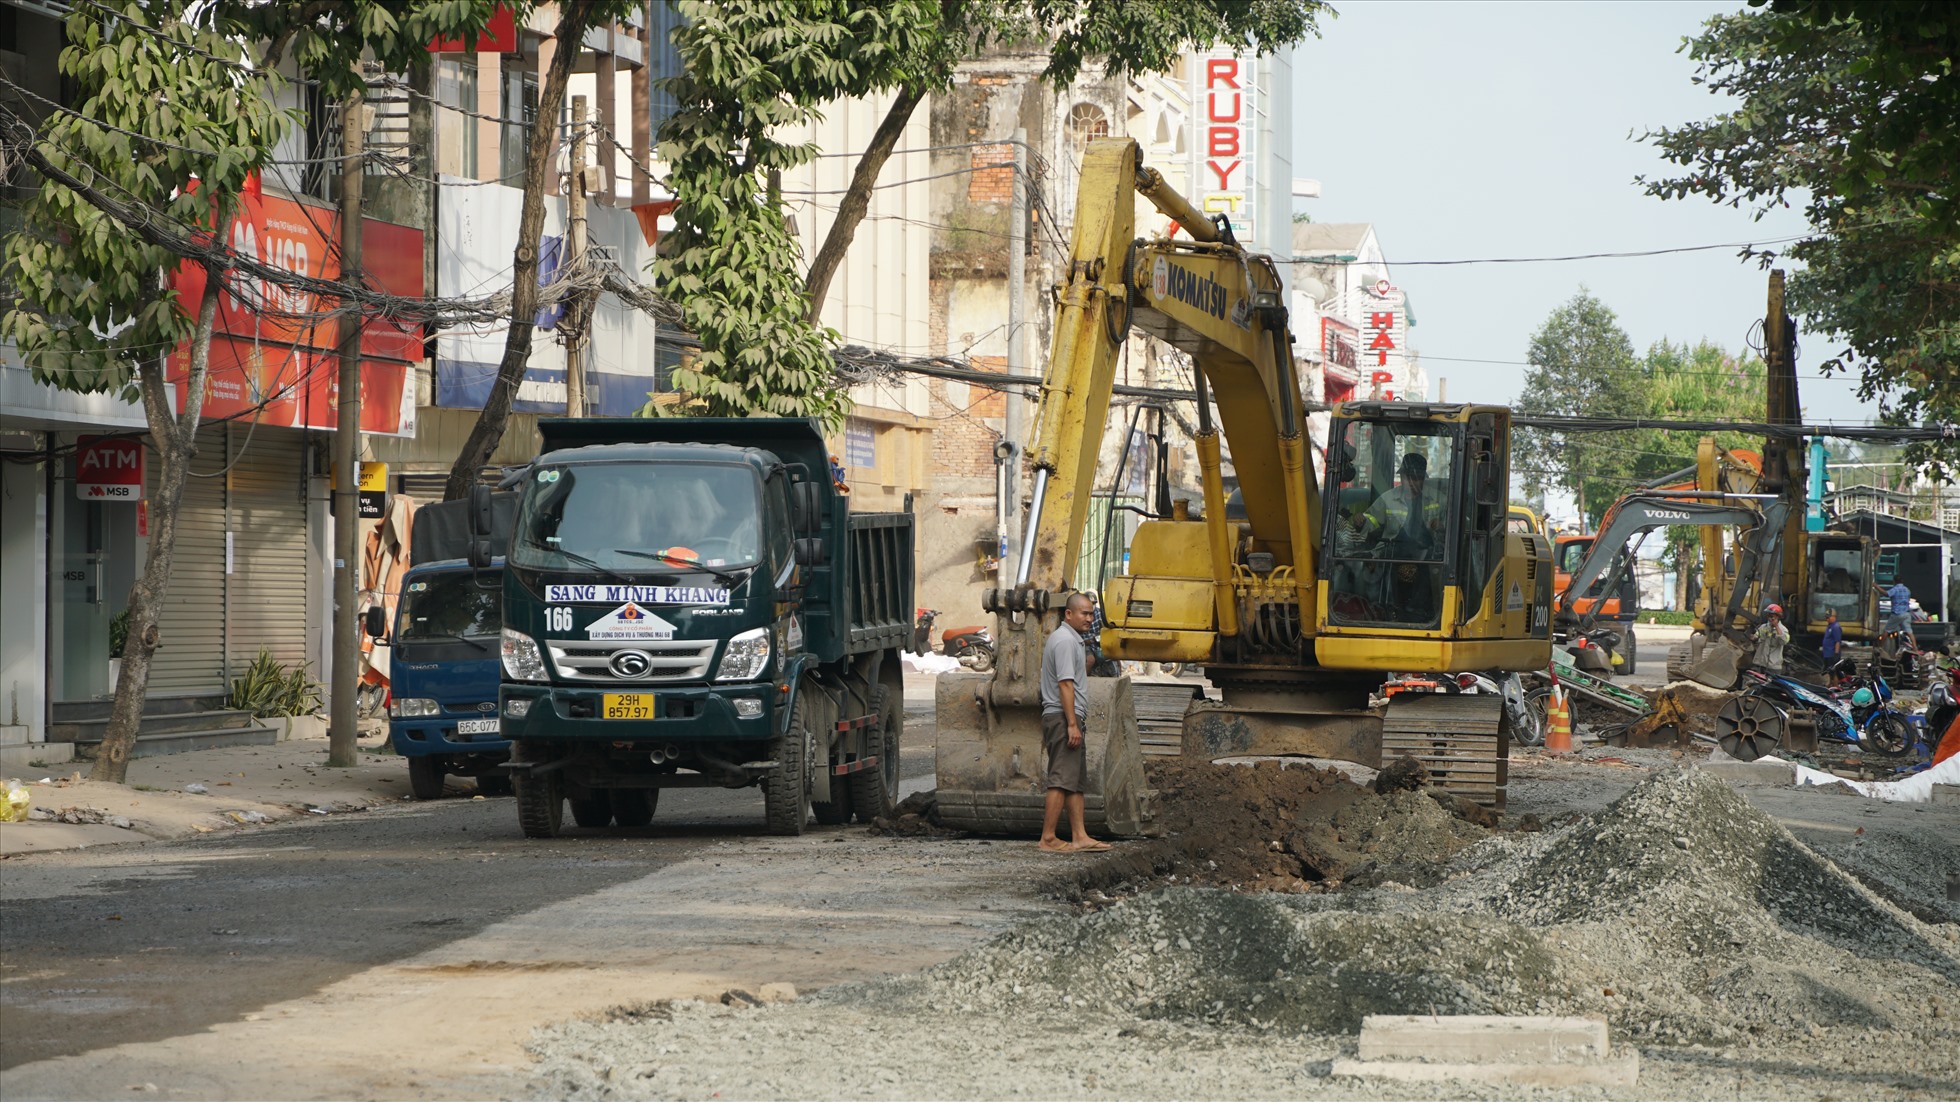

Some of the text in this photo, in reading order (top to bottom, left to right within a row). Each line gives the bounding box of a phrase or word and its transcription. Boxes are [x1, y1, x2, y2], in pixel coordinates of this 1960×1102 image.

[1207, 58, 1241, 190] RUBY
[1203, 195, 1243, 213] CT
[266, 235, 308, 314] MSB
[1167, 261, 1227, 321] KOMATSU
[82, 448, 137, 469] ATM
[106, 487, 130, 496] MSB
[1643, 509, 1691, 520] VOLVO
[62, 571, 85, 581] MSB
[550, 585, 728, 603] SANG MINH KHANG
[544, 606, 573, 631] 166
[691, 608, 744, 616] FORLAND
[1535, 606, 1548, 627] 200
[618, 694, 640, 706] 29H
[608, 706, 648, 718] 857.97
